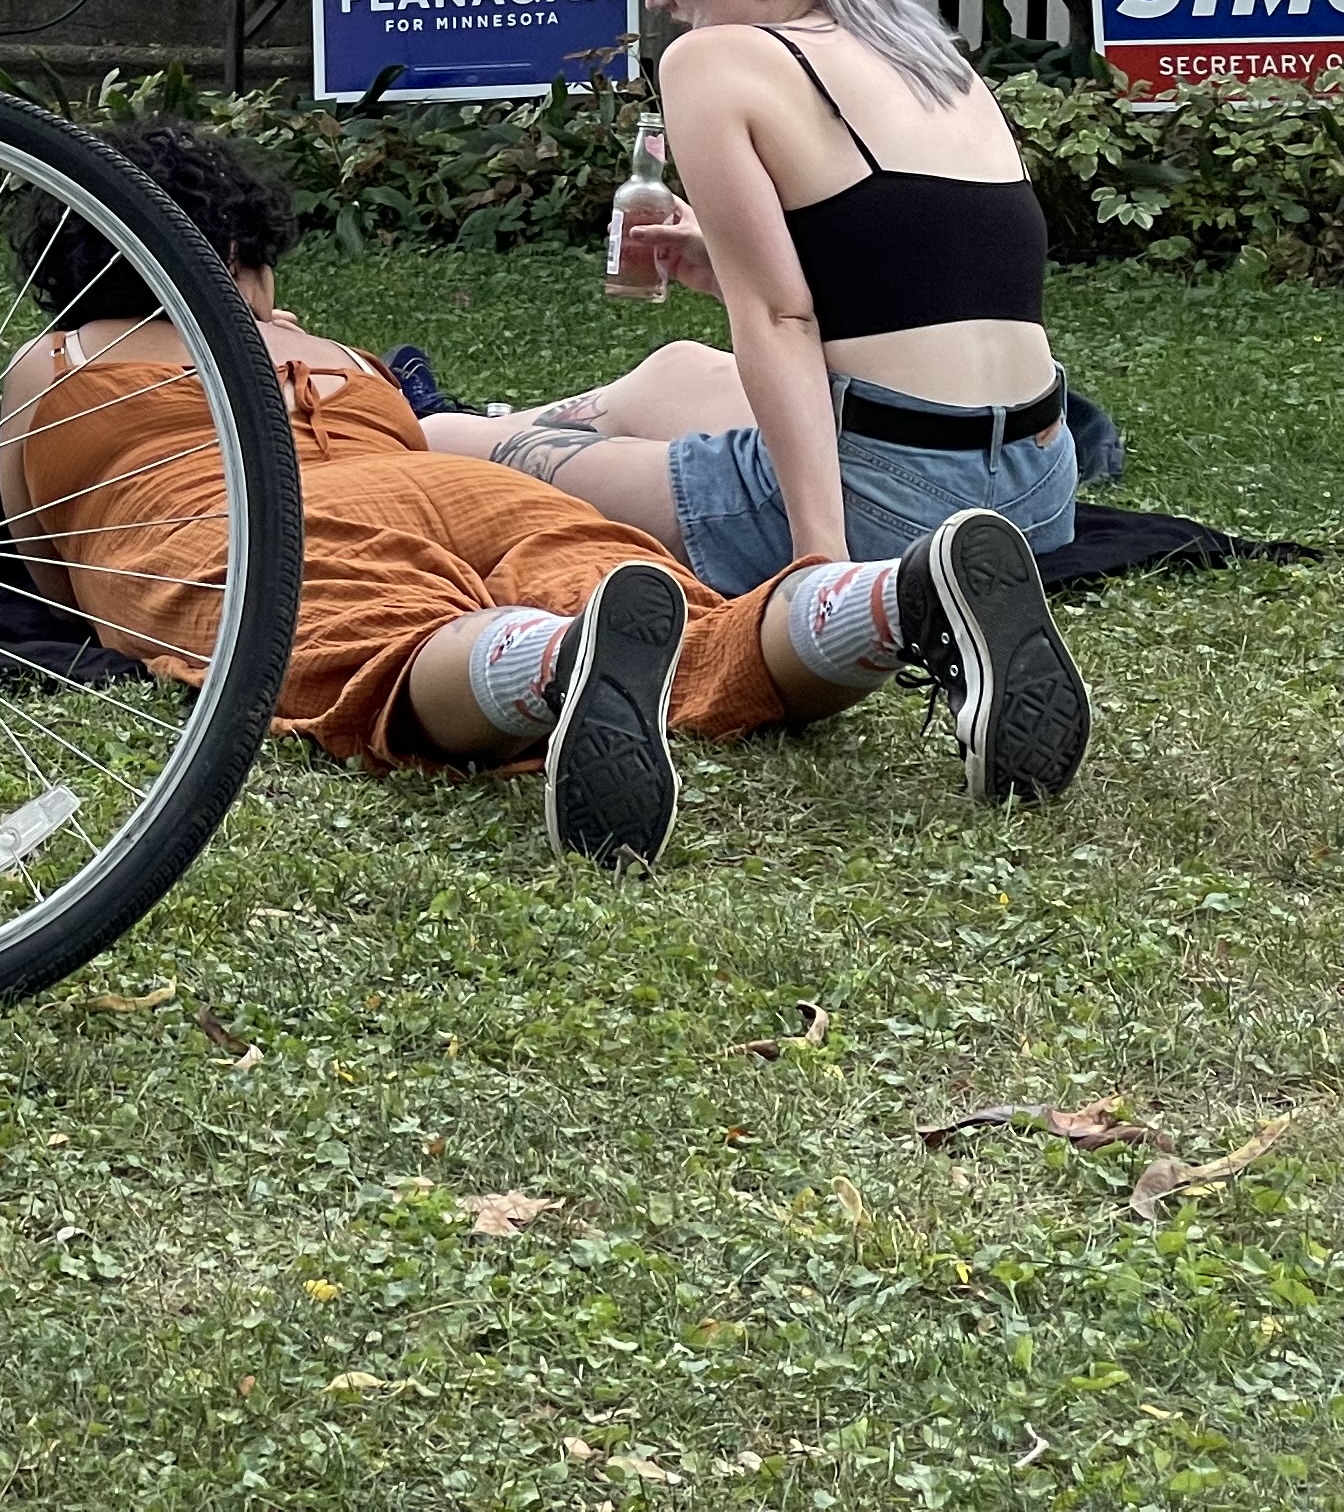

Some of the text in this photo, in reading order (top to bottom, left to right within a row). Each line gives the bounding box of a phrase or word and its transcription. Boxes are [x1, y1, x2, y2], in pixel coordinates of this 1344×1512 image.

[385, 11, 560, 33] FOR MINNESOTA
[1159, 54, 1315, 76] SECRETARY
